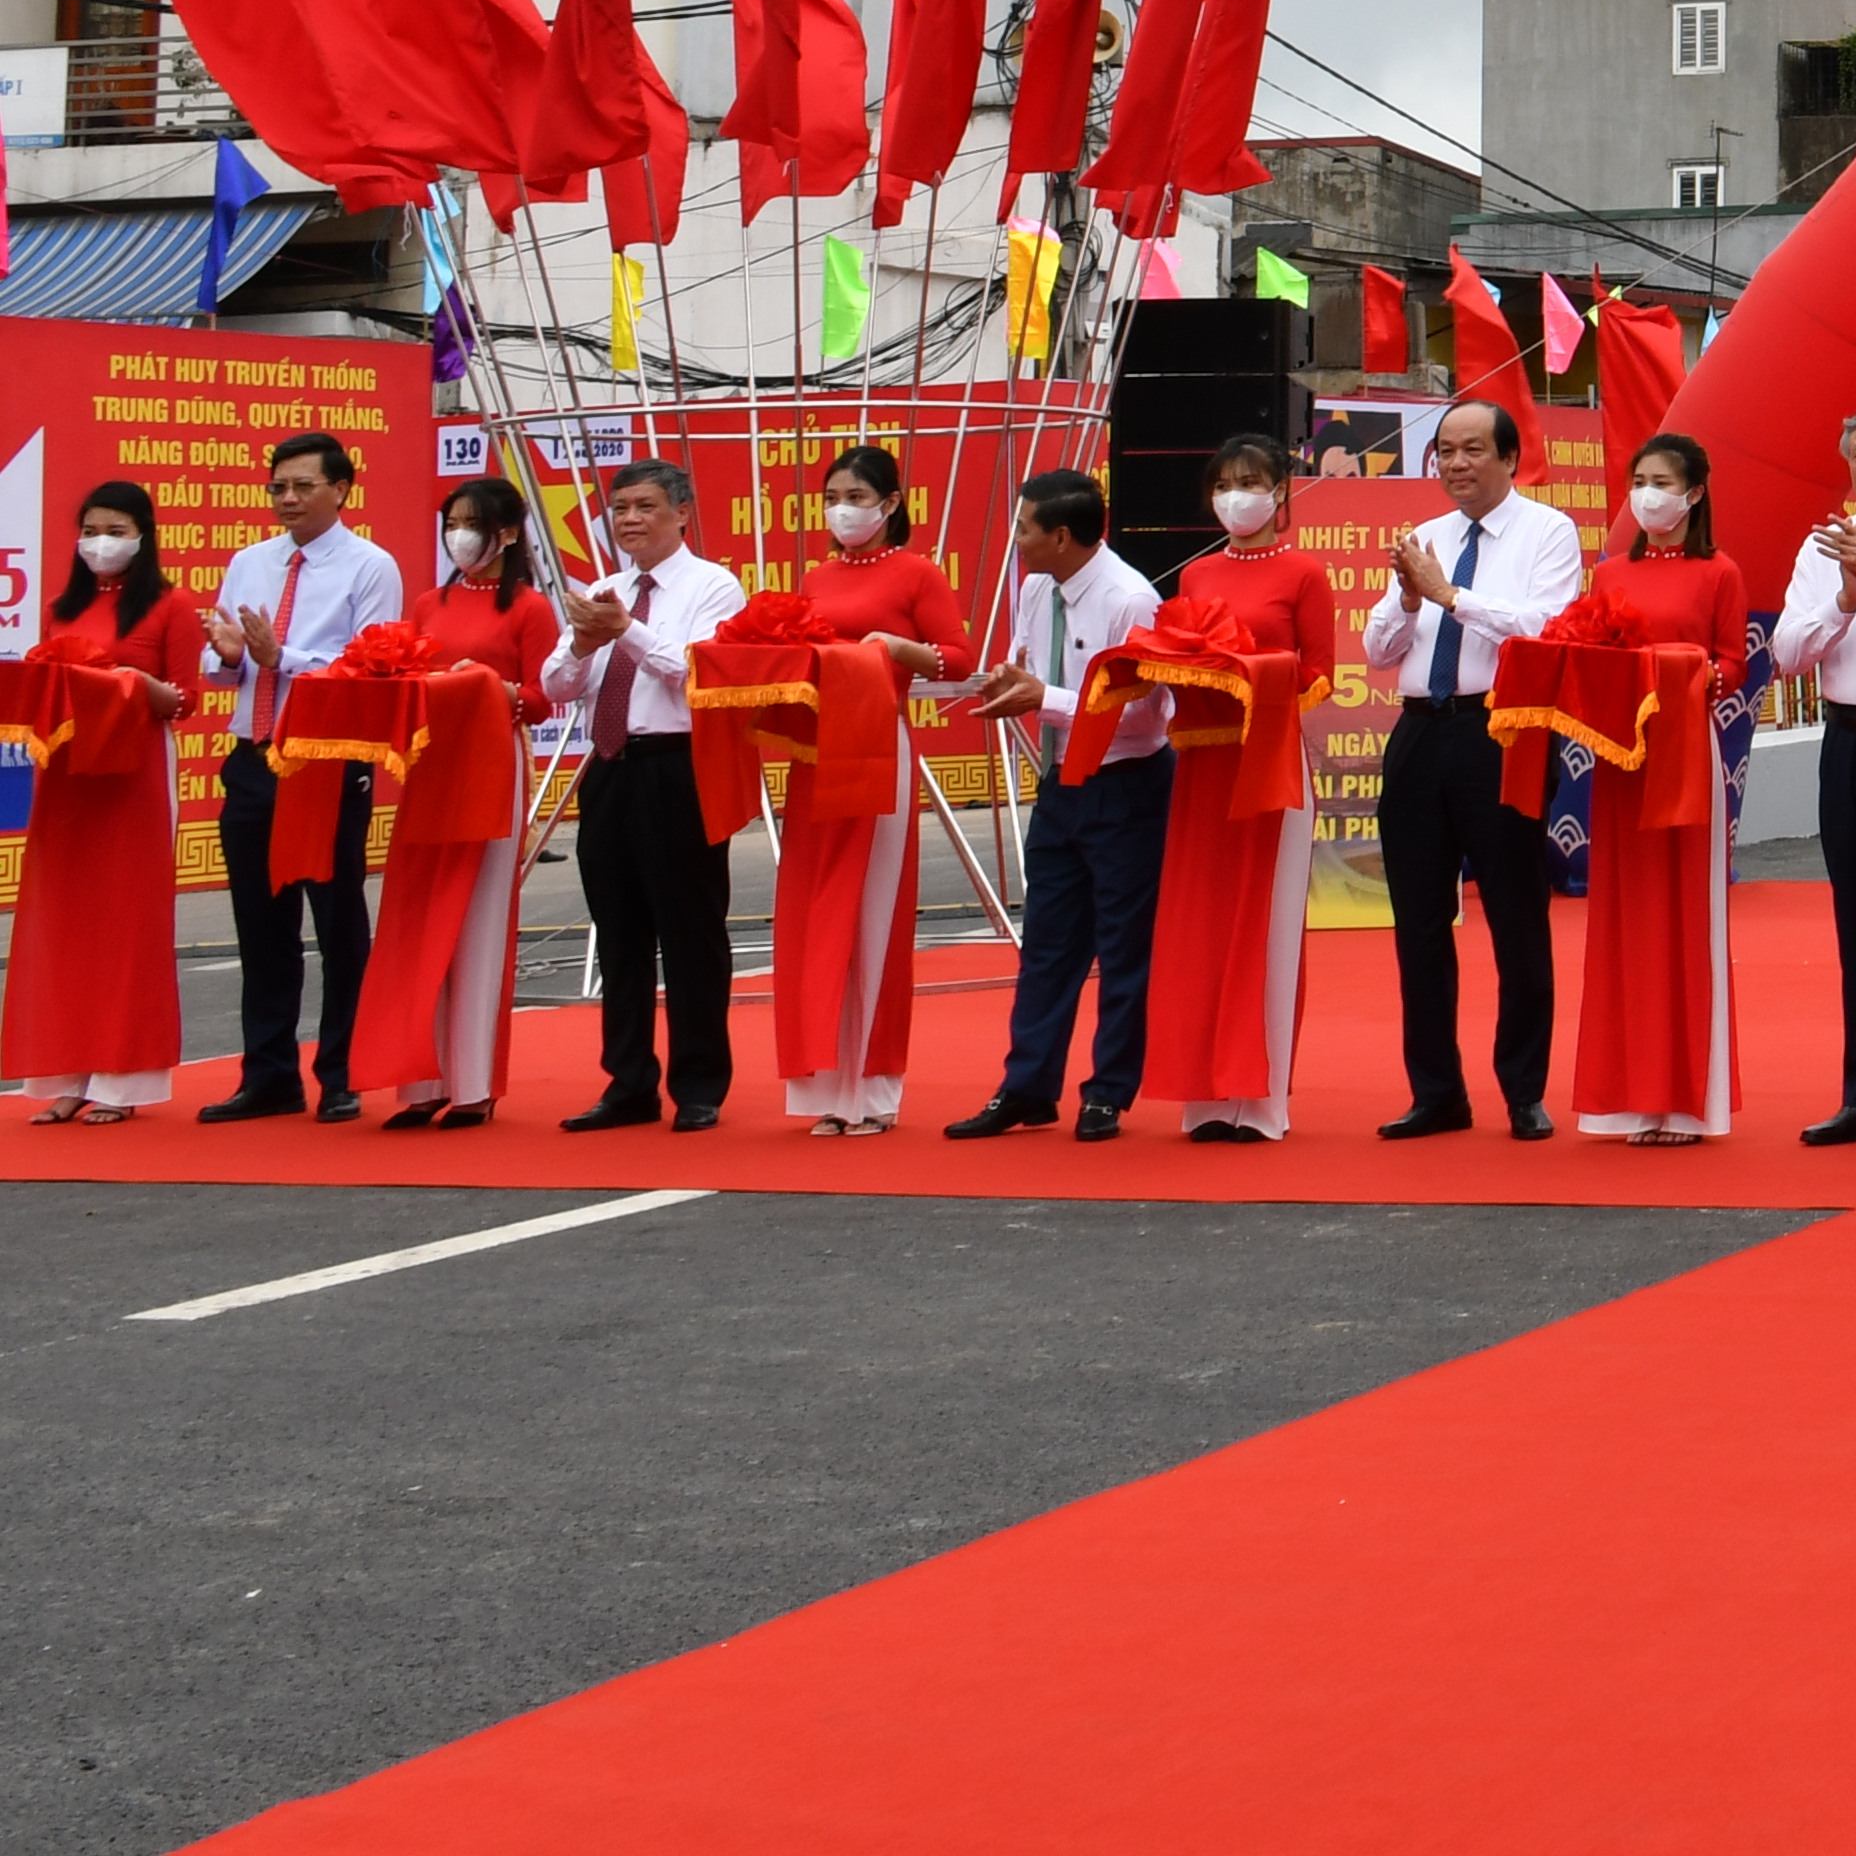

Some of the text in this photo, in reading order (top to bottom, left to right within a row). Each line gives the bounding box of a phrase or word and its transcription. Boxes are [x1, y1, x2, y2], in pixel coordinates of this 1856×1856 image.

[109, 351, 377, 392] PHÁT HUY TRUYỀN THỐNG
[92, 395, 390, 434] TRUNG DŨNG, QUYẾT THẮNG,
[118, 435, 183, 465] NĂNG
[189, 437, 256, 472] ĐỘNG,
[444, 437, 481, 460] 130
[759, 413, 821, 468] CHỦ
[157, 475, 203, 508] ĐẦU
[1298, 521, 1371, 555] NHIỆT
